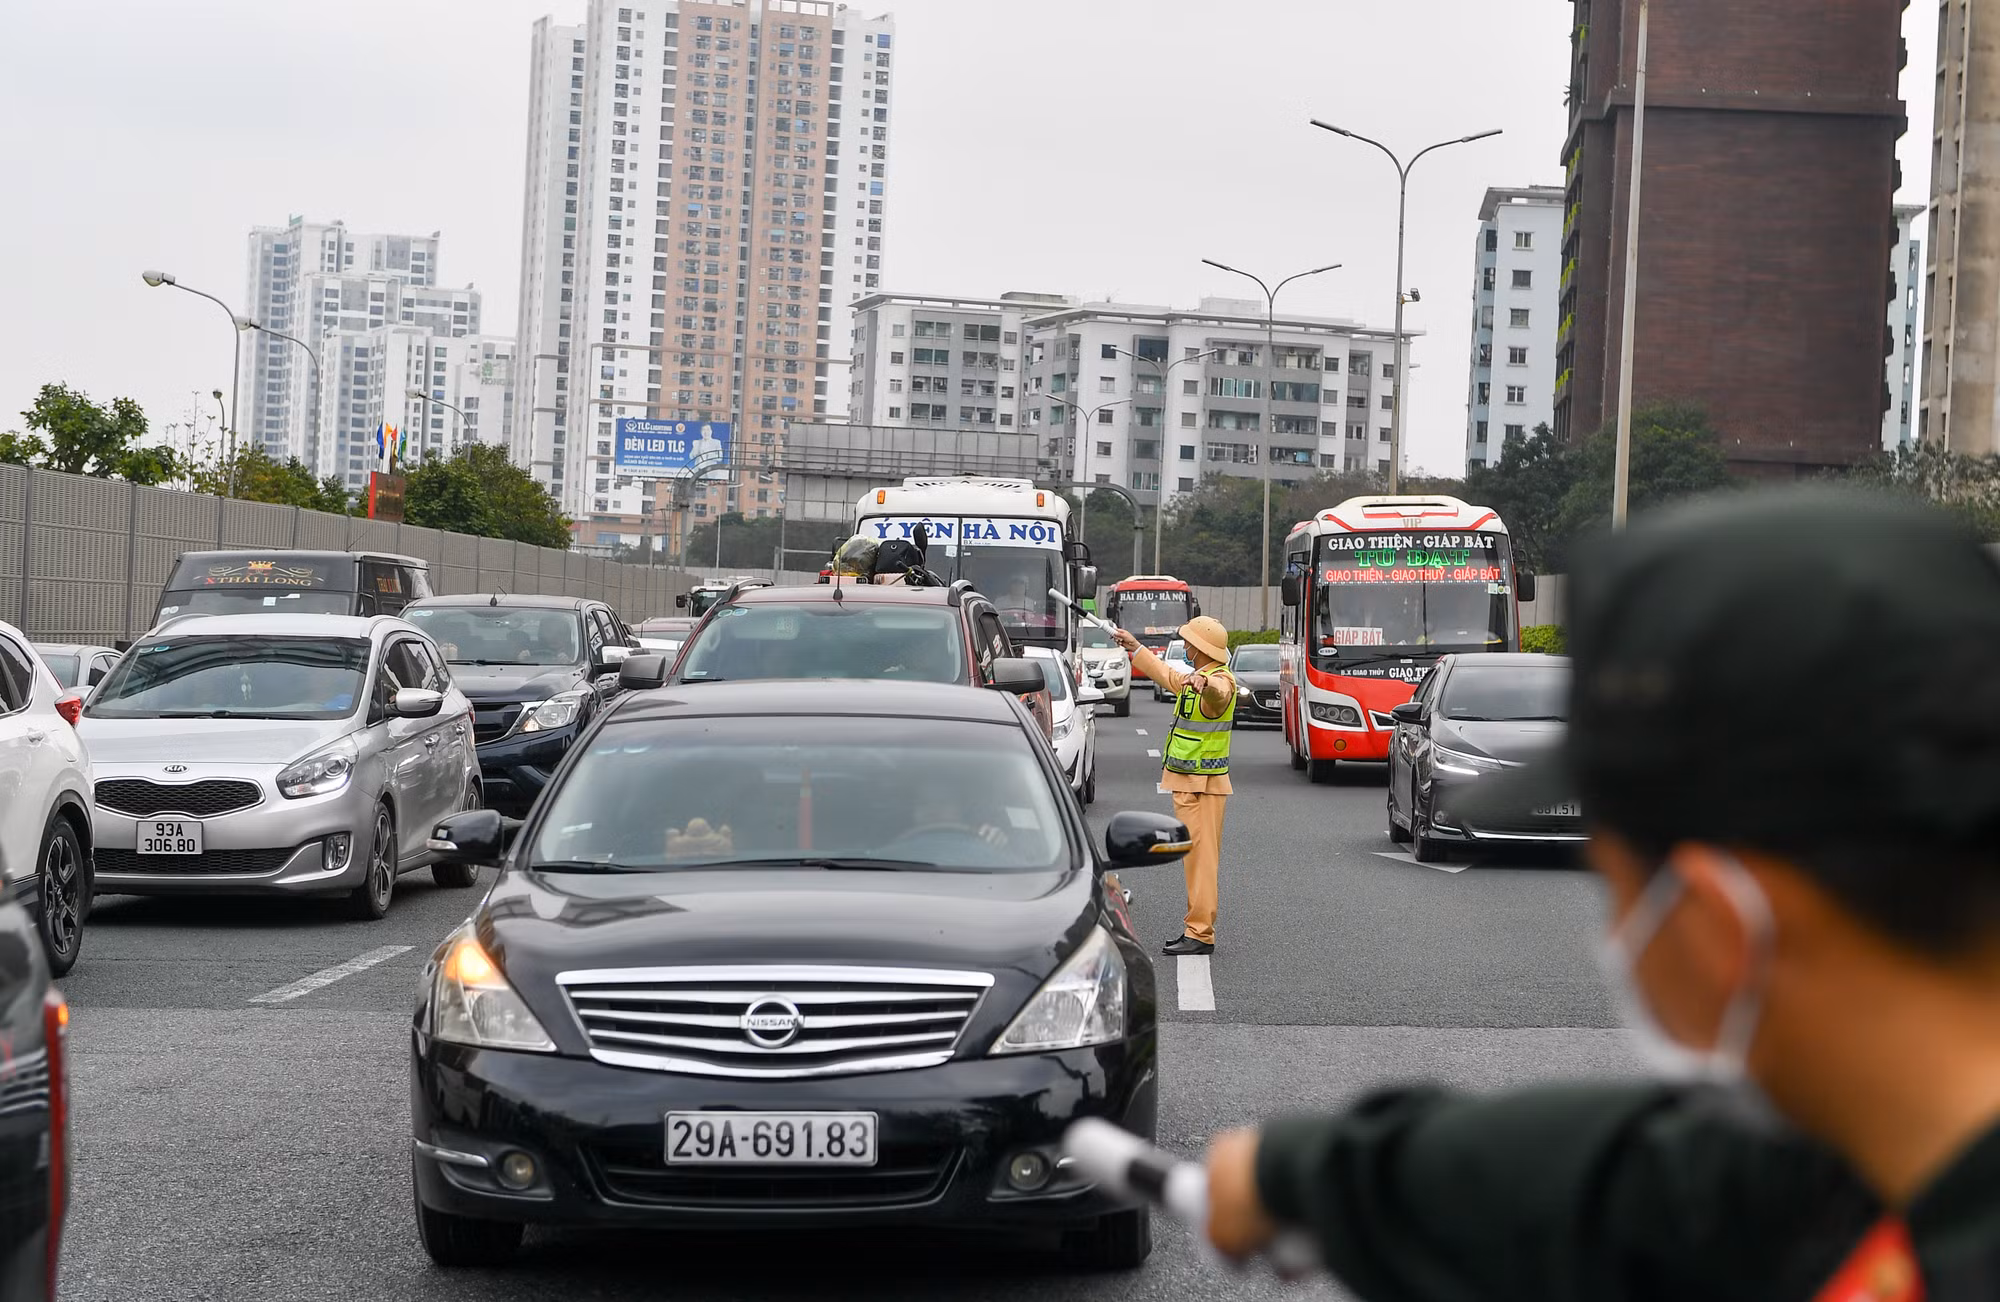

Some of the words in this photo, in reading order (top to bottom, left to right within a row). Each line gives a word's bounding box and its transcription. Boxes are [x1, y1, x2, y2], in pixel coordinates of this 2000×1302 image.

[637, 422, 650, 431] TLC
[624, 436, 645, 451] ĐÈN
[647, 439, 665, 452] LED
[667, 440, 685, 453] TLC
[874, 517, 893, 538] Ý
[898, 517, 954, 539] YÊN
[1403, 518, 1421, 528] VIP
[963, 519, 1001, 539] HÀ
[1009, 521, 1055, 545] NỘI
[1328, 537, 1365, 550] GIAO
[1368, 533, 1413, 551] THIỆN
[1423, 533, 1460, 548] GIÁP
[1464, 533, 1494, 548] BÁT
[1407, 549, 1470, 568] ĐẠT
[263, 577, 312, 586] LONG
[1326, 569, 1351, 581] GIAO
[1353, 567, 1383, 583] THIỆN
[1391, 569, 1416, 581] GIAO
[1454, 566, 1478, 580] GIÁP
[1480, 566, 1500, 580] BÁT
[1136, 591, 1154, 602] HẬU
[1159, 591, 1171, 601] HÀ
[1172, 591, 1187, 602] NỘI
[1335, 628, 1358, 645] GIÁP
[1361, 628, 1381, 645] BÁT
[1389, 667, 1413, 678] GIAO
[156, 823, 184, 837] 93A
[144, 838, 196, 853] 306.80
[748, 1018, 798, 1026] NISSAN
[672, 1119, 869, 1158] 29A-691.83
